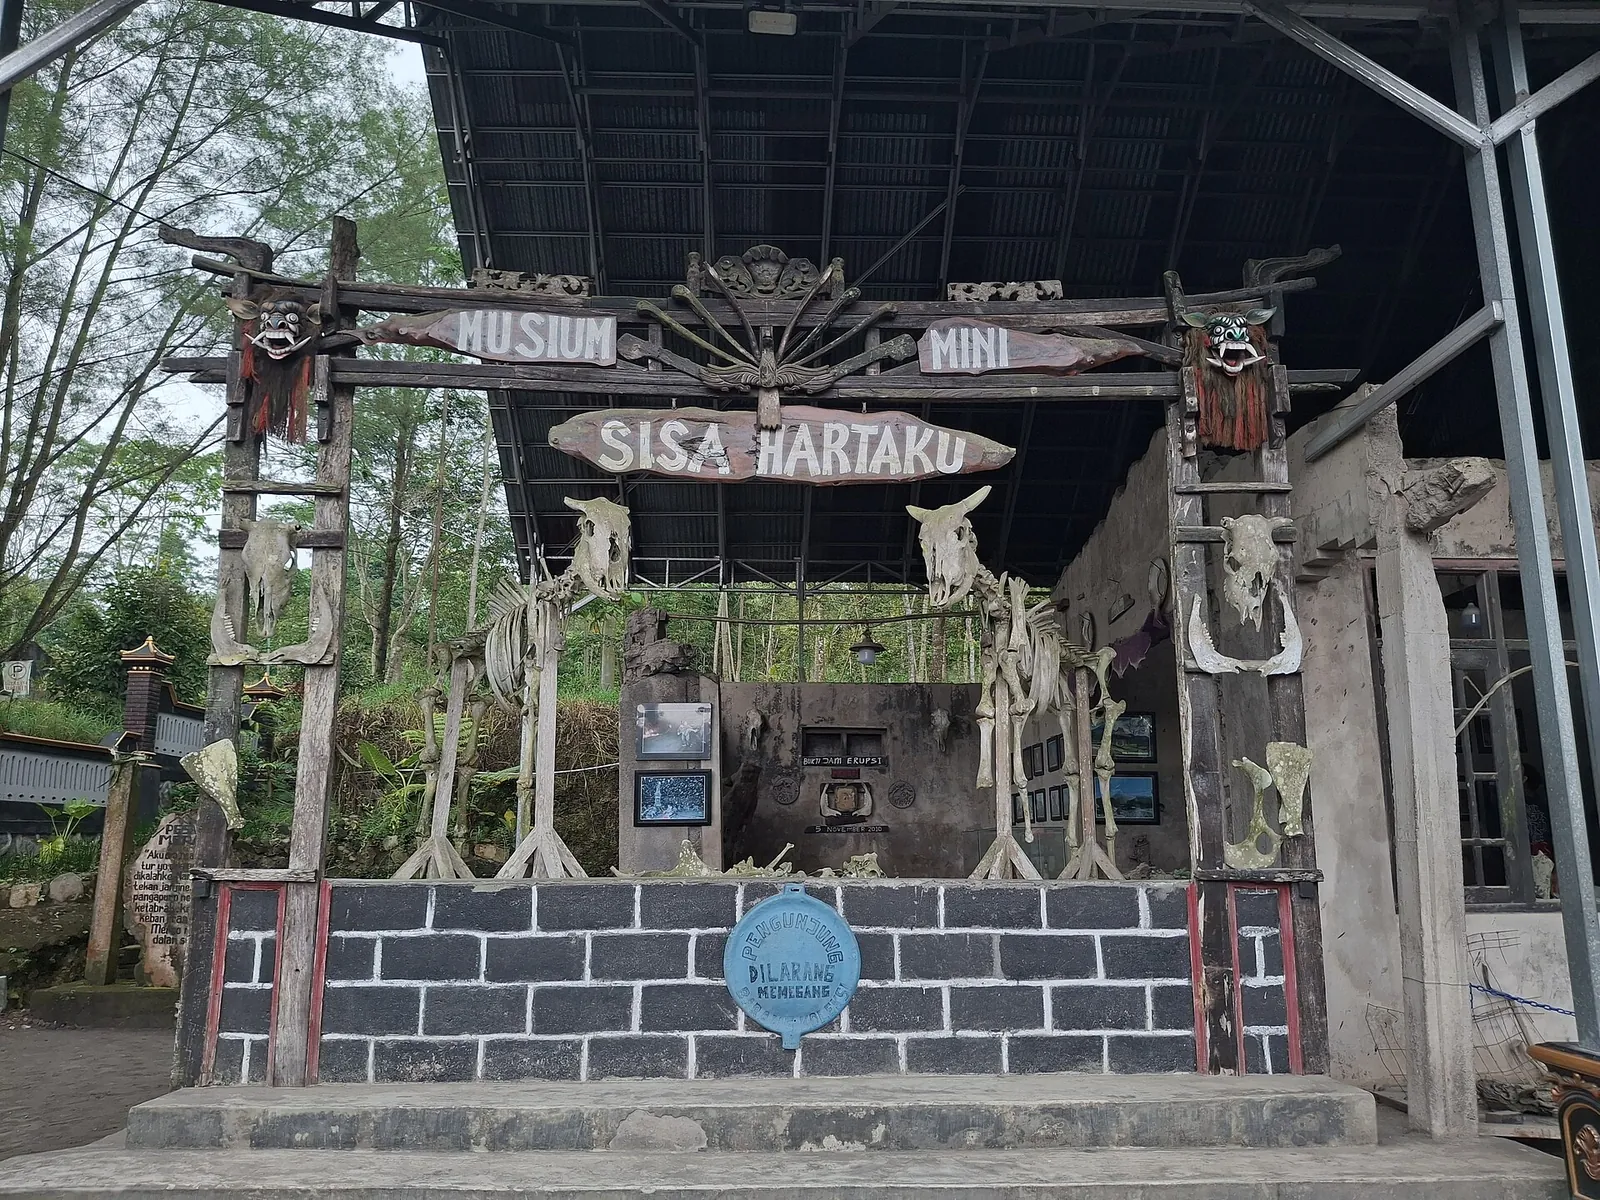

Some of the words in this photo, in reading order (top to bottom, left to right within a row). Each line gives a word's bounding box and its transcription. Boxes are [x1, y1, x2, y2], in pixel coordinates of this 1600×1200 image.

[457, 310, 610, 361] MUSIUM
[930, 326, 1010, 371] MINI
[598, 420, 731, 476] SISA
[757, 423, 966, 476] HARTAKU
[847, 757, 882, 765] ERUPSI
[141, 861, 155, 871] tur
[133, 881, 159, 892] tekan
[742, 912, 844, 964] PENGUNJUNG
[749, 963, 836, 983] DILARANG
[757, 985, 831, 999] MEMEGANG
